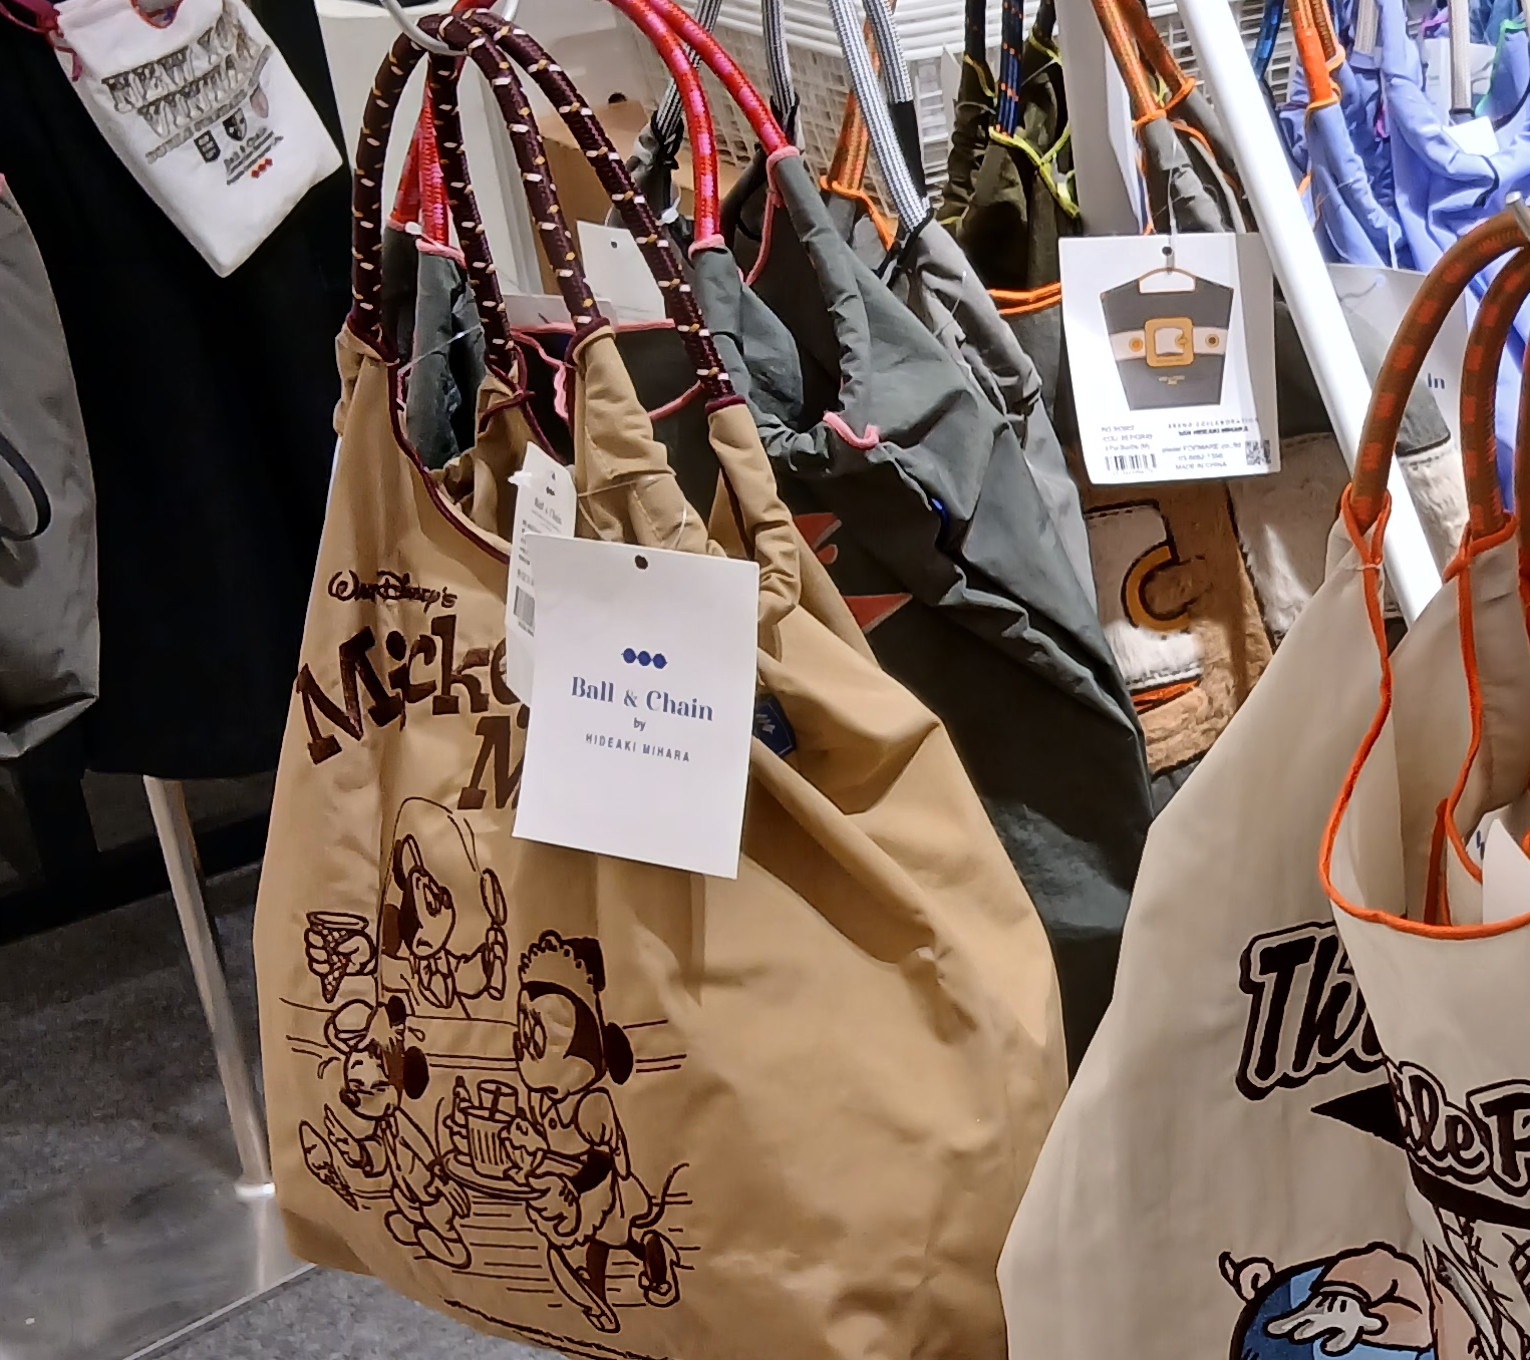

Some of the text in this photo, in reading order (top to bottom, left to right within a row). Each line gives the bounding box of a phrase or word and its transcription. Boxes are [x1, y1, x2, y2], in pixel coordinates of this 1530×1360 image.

[572, 676, 713, 721] Ball & Chain
[633, 717, 646, 732] by
[585, 733, 690, 763] HIDEAKI MIHARA
